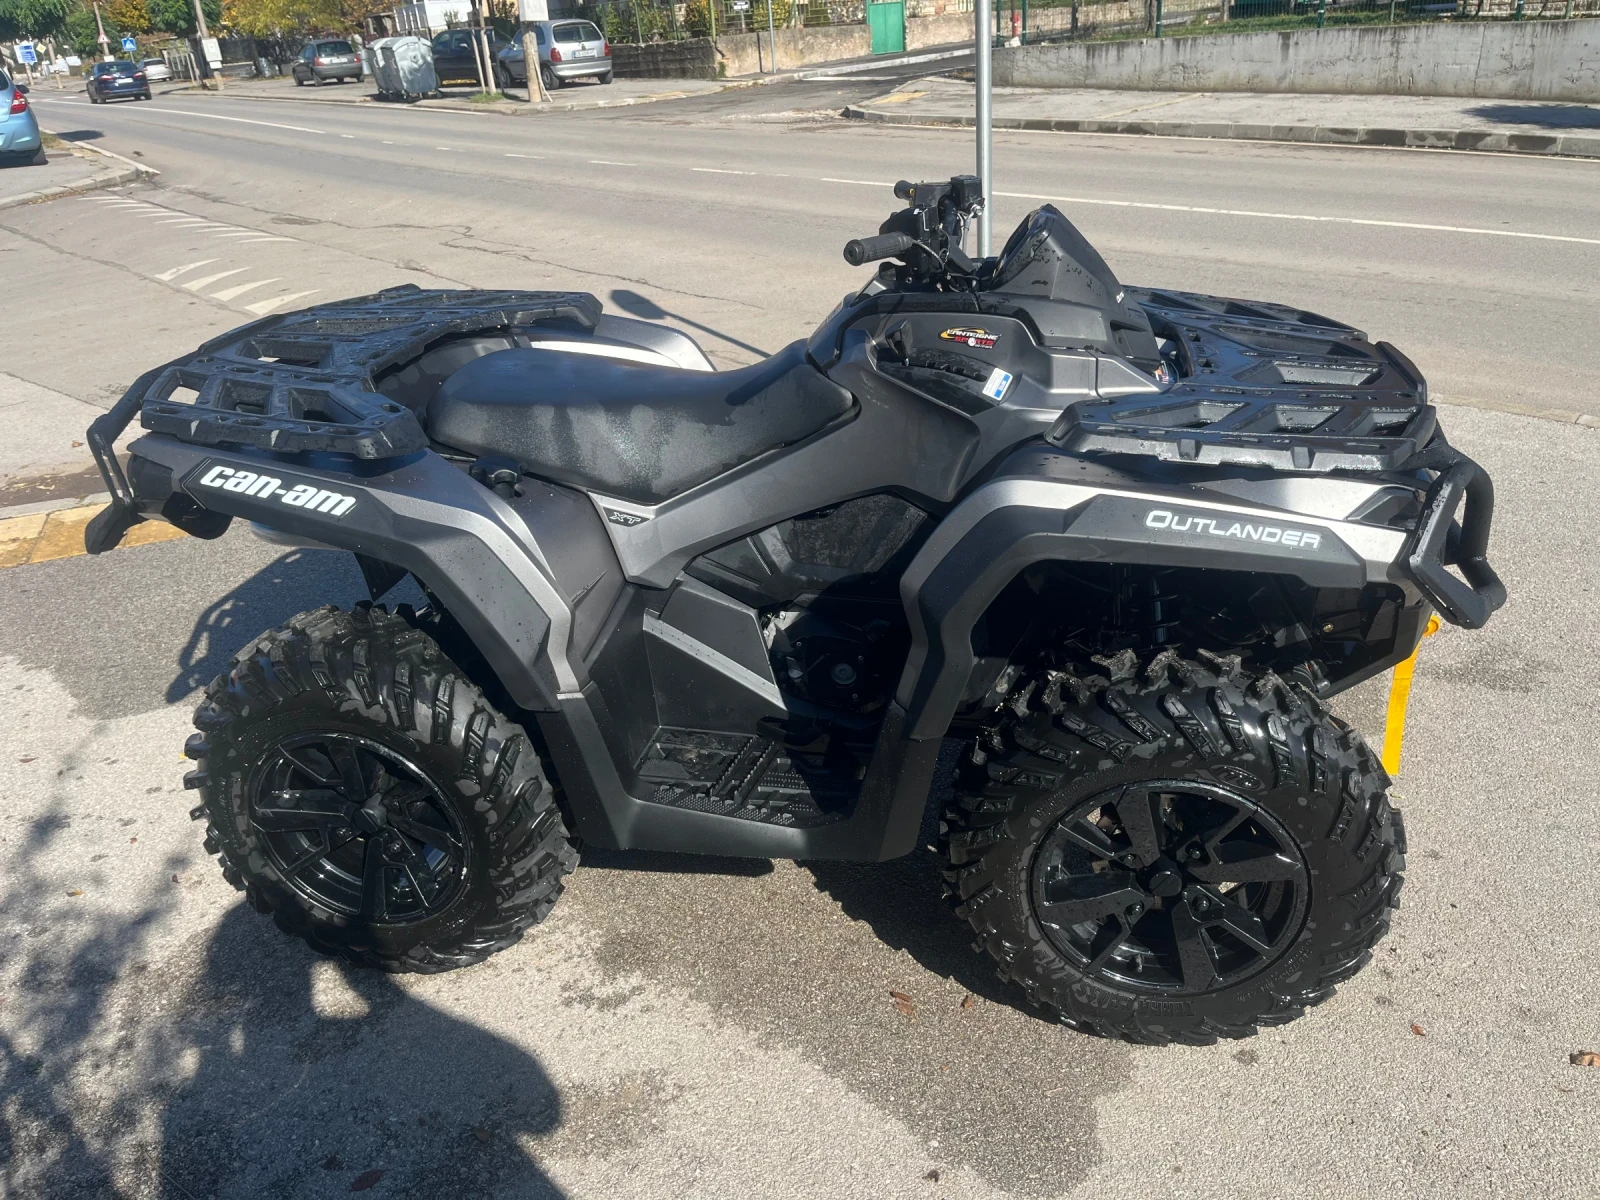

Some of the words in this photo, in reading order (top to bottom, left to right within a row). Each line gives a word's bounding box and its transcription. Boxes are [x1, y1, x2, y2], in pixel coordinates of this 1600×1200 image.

[199, 465, 357, 517] can-am
[608, 511, 642, 524] XT
[1145, 509, 1322, 549] OUTLANDER
